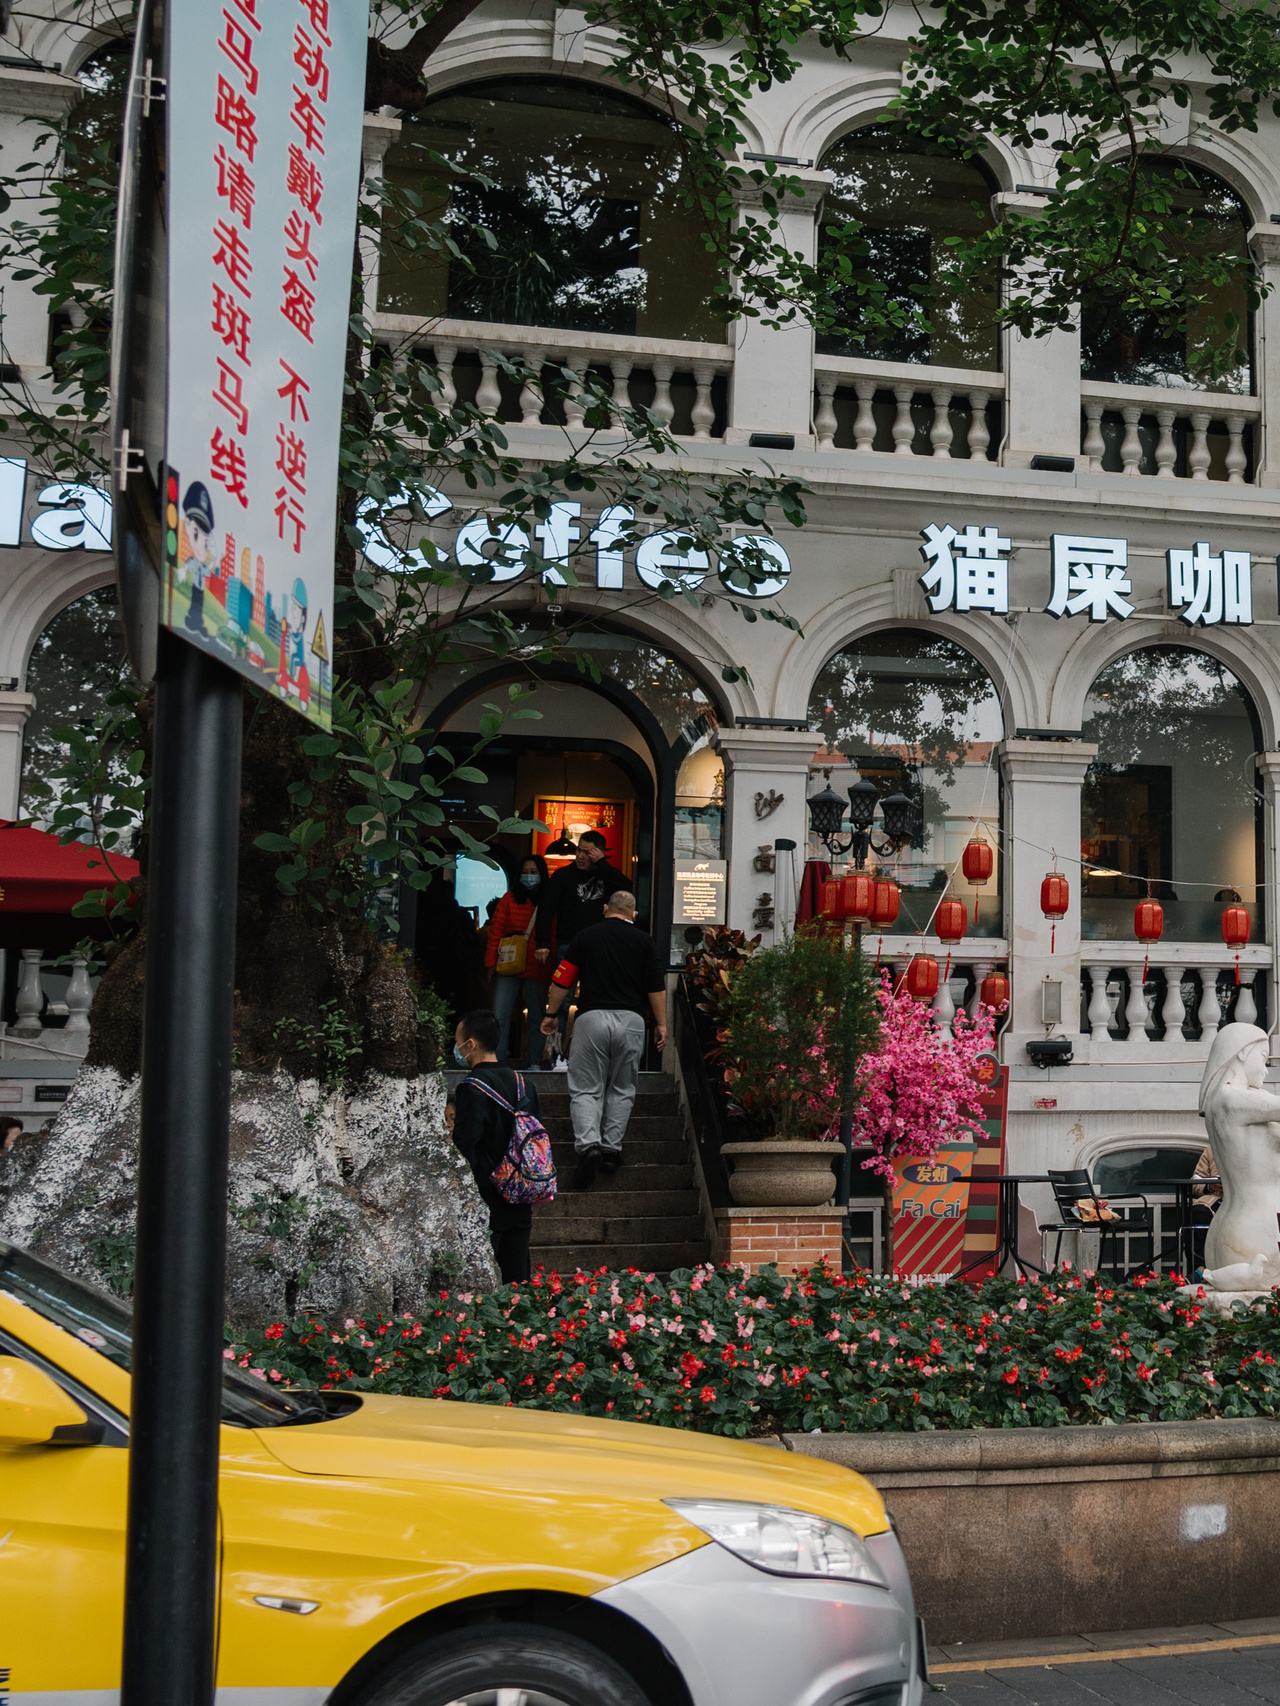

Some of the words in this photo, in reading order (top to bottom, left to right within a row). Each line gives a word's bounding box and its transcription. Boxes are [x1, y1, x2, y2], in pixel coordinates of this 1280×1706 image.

[274, 357, 311, 555] 不逆行
[916, 1165, 949, 1183] 发财
[899, 1199, 925, 1218] Fa
[929, 1198, 961, 1218] Cai
